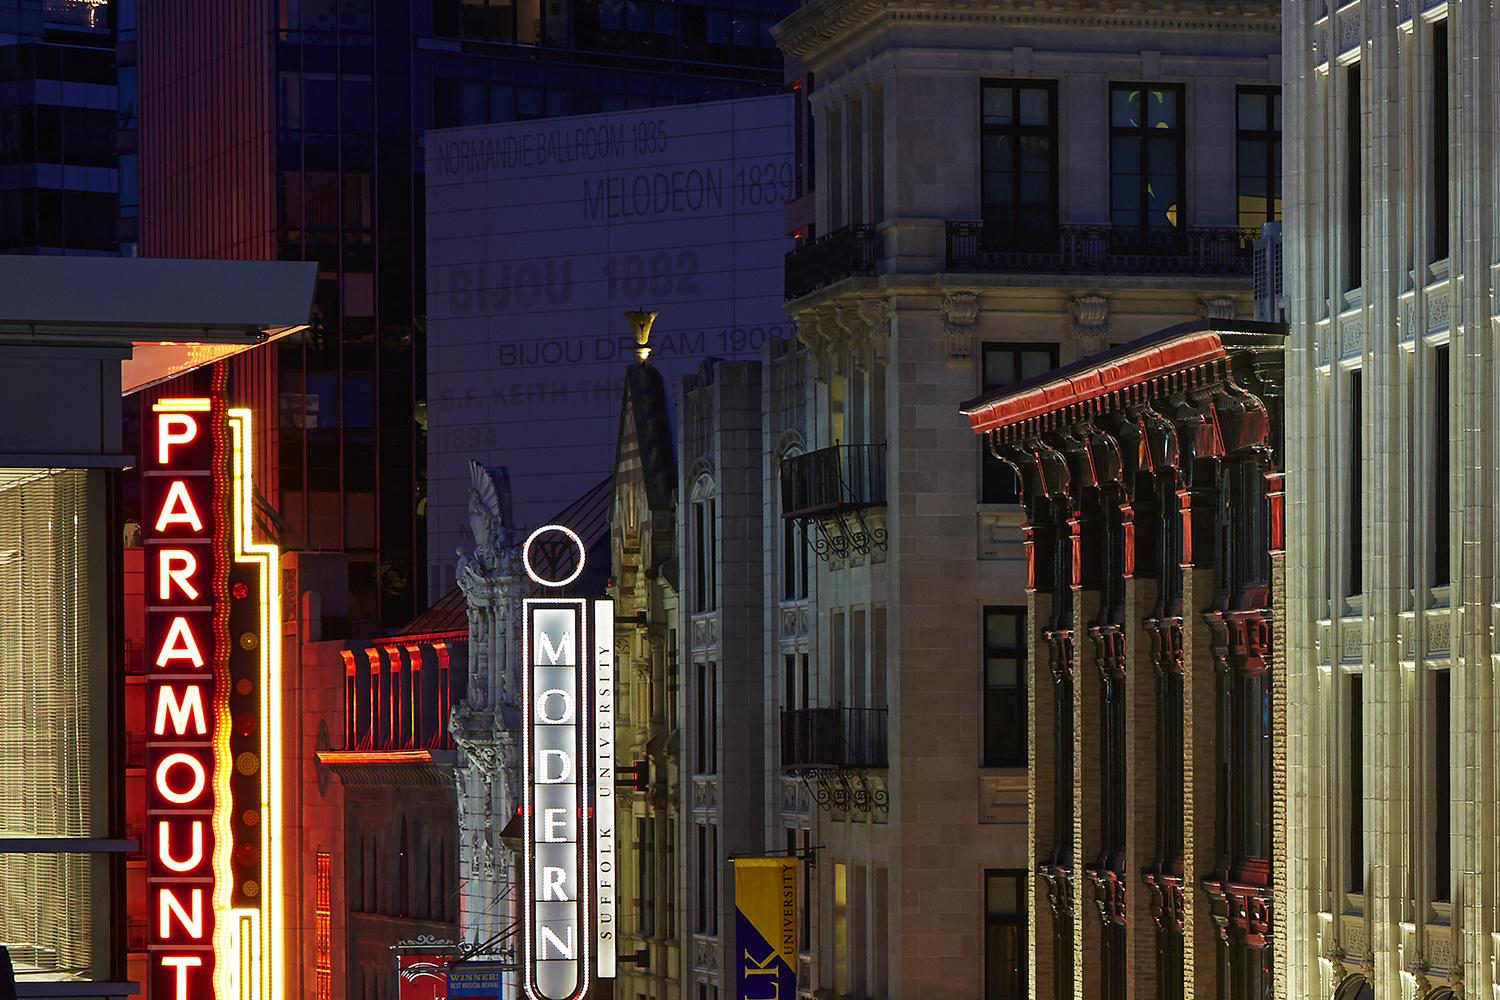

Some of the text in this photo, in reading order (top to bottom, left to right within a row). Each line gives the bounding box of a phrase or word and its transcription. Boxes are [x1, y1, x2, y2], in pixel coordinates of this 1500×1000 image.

[438, 120, 667, 175] NORMANDIE BALLROOM 1935
[583, 162, 794, 220] MELODEON 1839
[448, 250, 701, 312] BIJOU 1882
[499, 337, 583, 366] BIJOU
[438, 383, 485, 412] B.F.
[491, 379, 568, 408] KEITH
[439, 425, 498, 450] 1894
[535, 631, 575, 961] MODERN
[599, 646, 612, 940] SUFFOLK UNIVERSITY
[782, 863, 794, 955] UNIVERSITY
[450, 973, 499, 981] WINNER!
